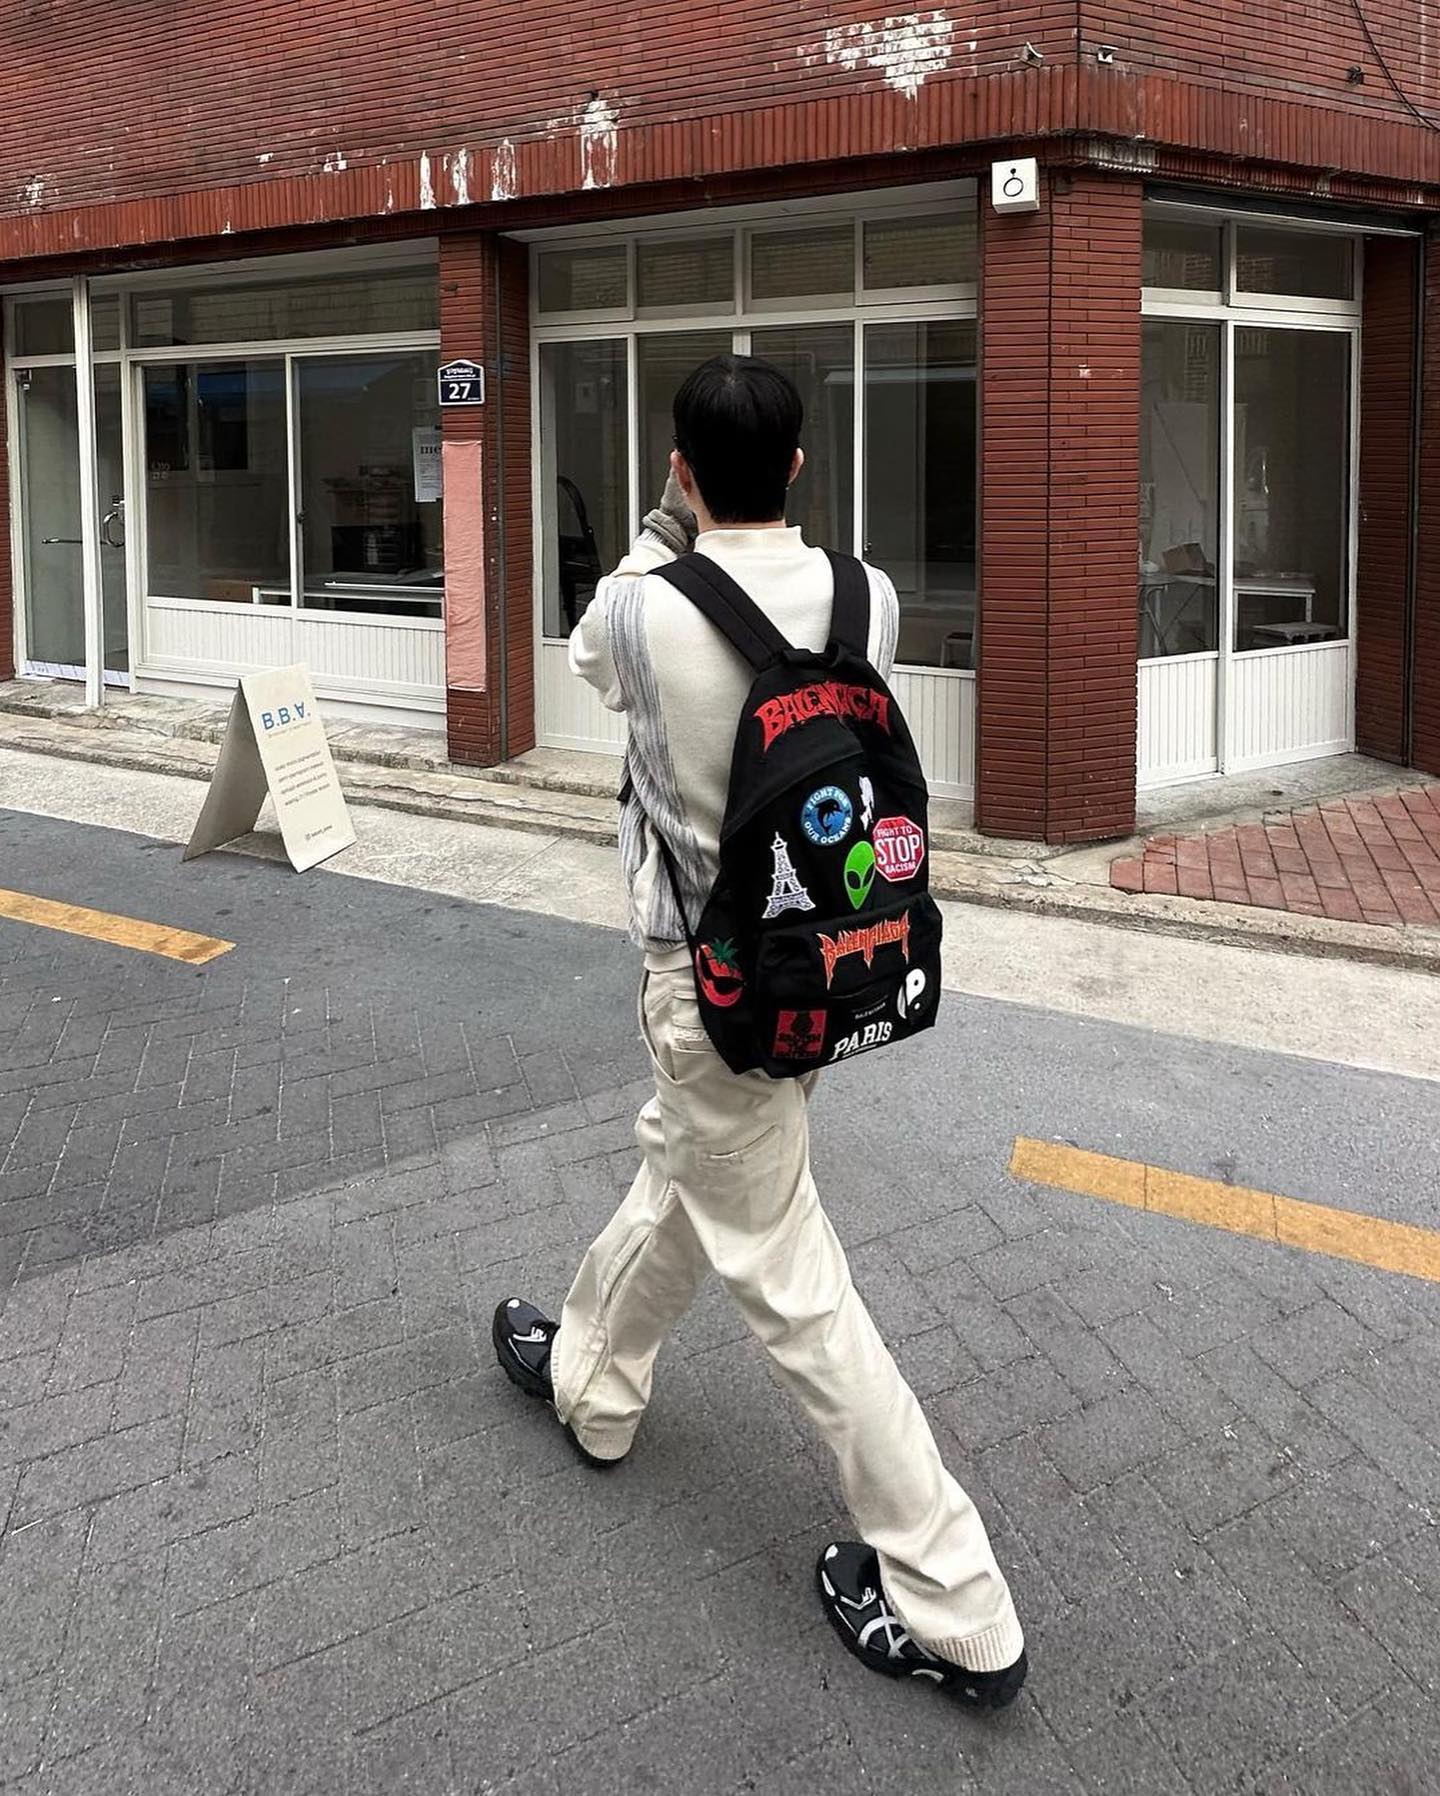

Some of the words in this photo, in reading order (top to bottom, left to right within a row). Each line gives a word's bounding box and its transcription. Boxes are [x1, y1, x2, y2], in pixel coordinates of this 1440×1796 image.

[449, 383, 471, 400] 27
[806, 788, 833, 810] FIGHT
[804, 821, 820, 841] OUR
[877, 827, 899, 838] FIGHT
[900, 825, 913, 835] TO
[875, 834, 920, 865] STOP
[884, 860, 916, 874] RACISM
[828, 1021, 893, 1062] PARIS
